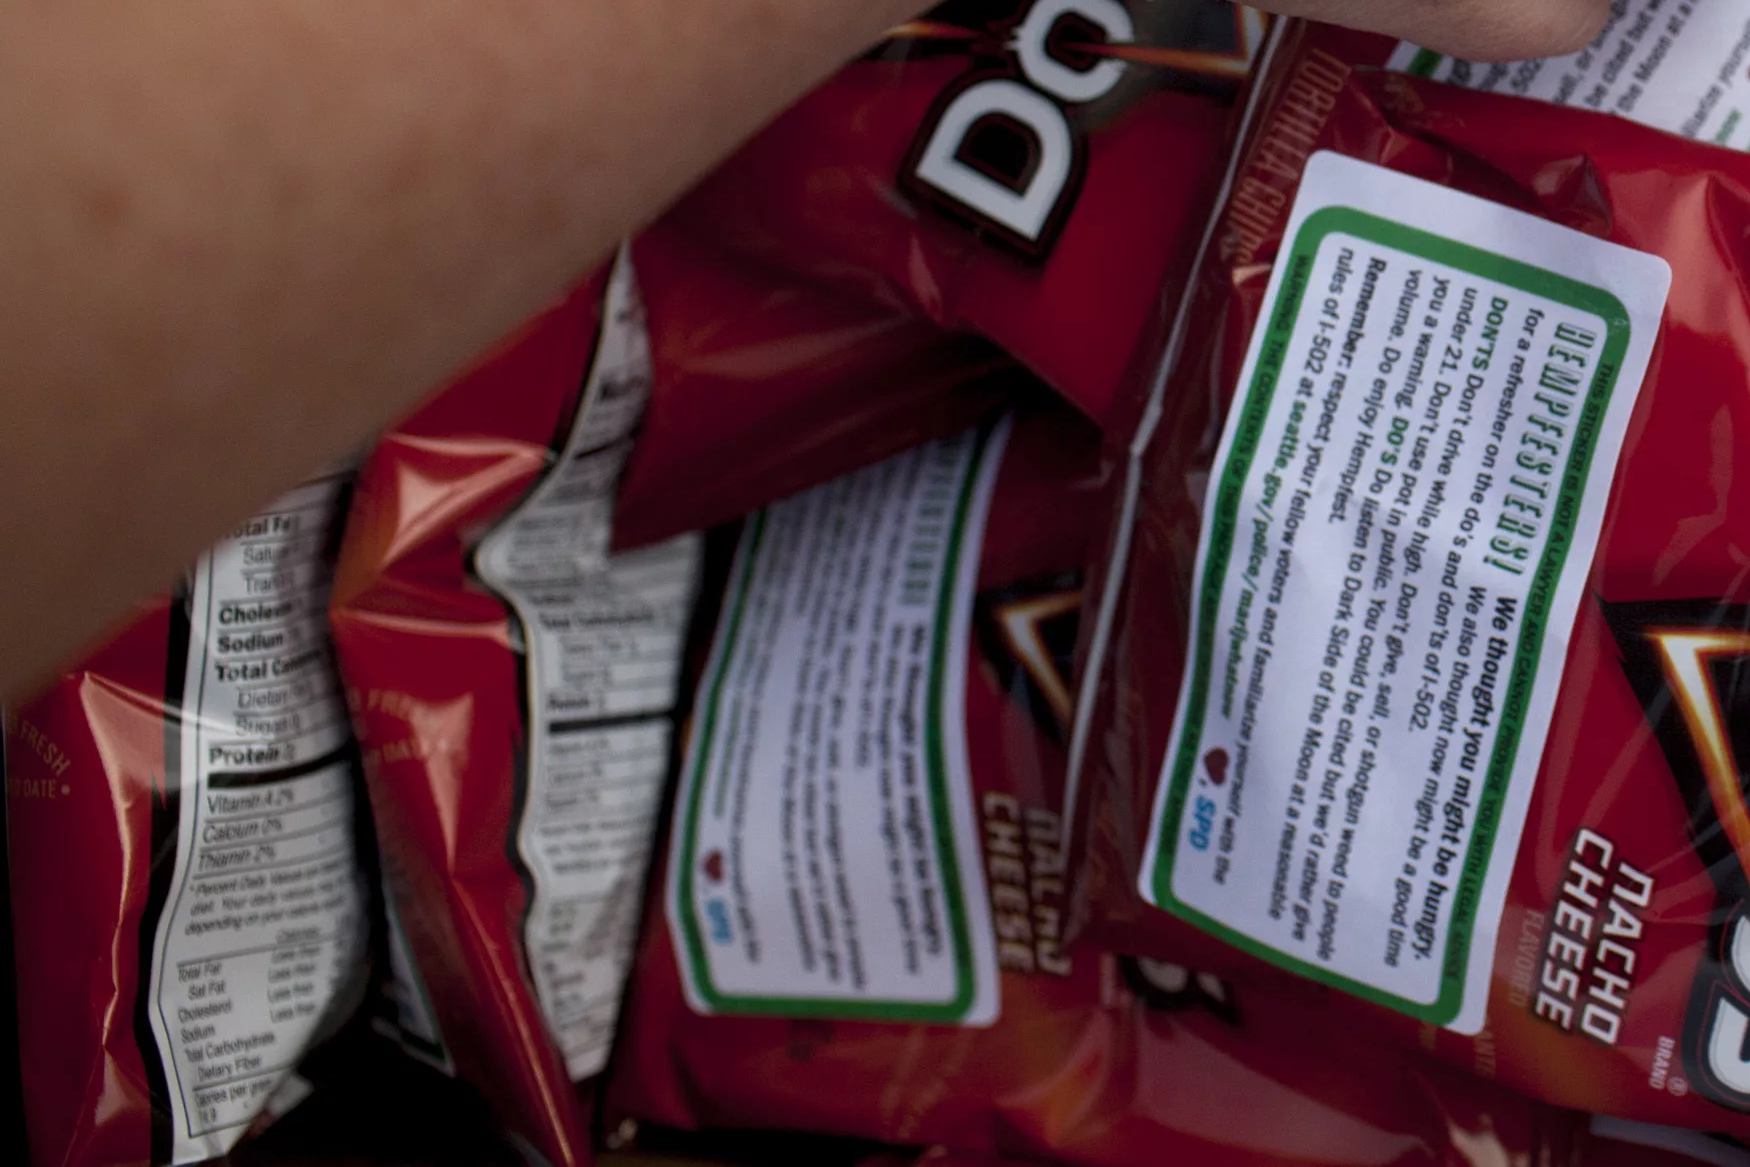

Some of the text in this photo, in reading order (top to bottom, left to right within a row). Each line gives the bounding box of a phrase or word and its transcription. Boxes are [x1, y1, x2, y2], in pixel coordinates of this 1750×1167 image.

[1189, 247, 1355, 852] rules of I-502 at seattle.gov/police/marijwhatnow SPD
[1327, 269, 1423, 525] volume. Do enjoy Hempfest.
[1407, 307, 1546, 733] for a refresher on the do's and don'ts of I-502.
[1317, 295, 1509, 961] DON'TS Don't drive while high. Don't give, sell, or shotgun weed to people
[1411, 322, 1596, 961] HEMPFESTERS! We thought you might be hungry.
[983, 790, 1036, 974] CHEESE
[1533, 827, 1616, 1031] CHEESE
[1580, 860, 1656, 1046] NACHO
